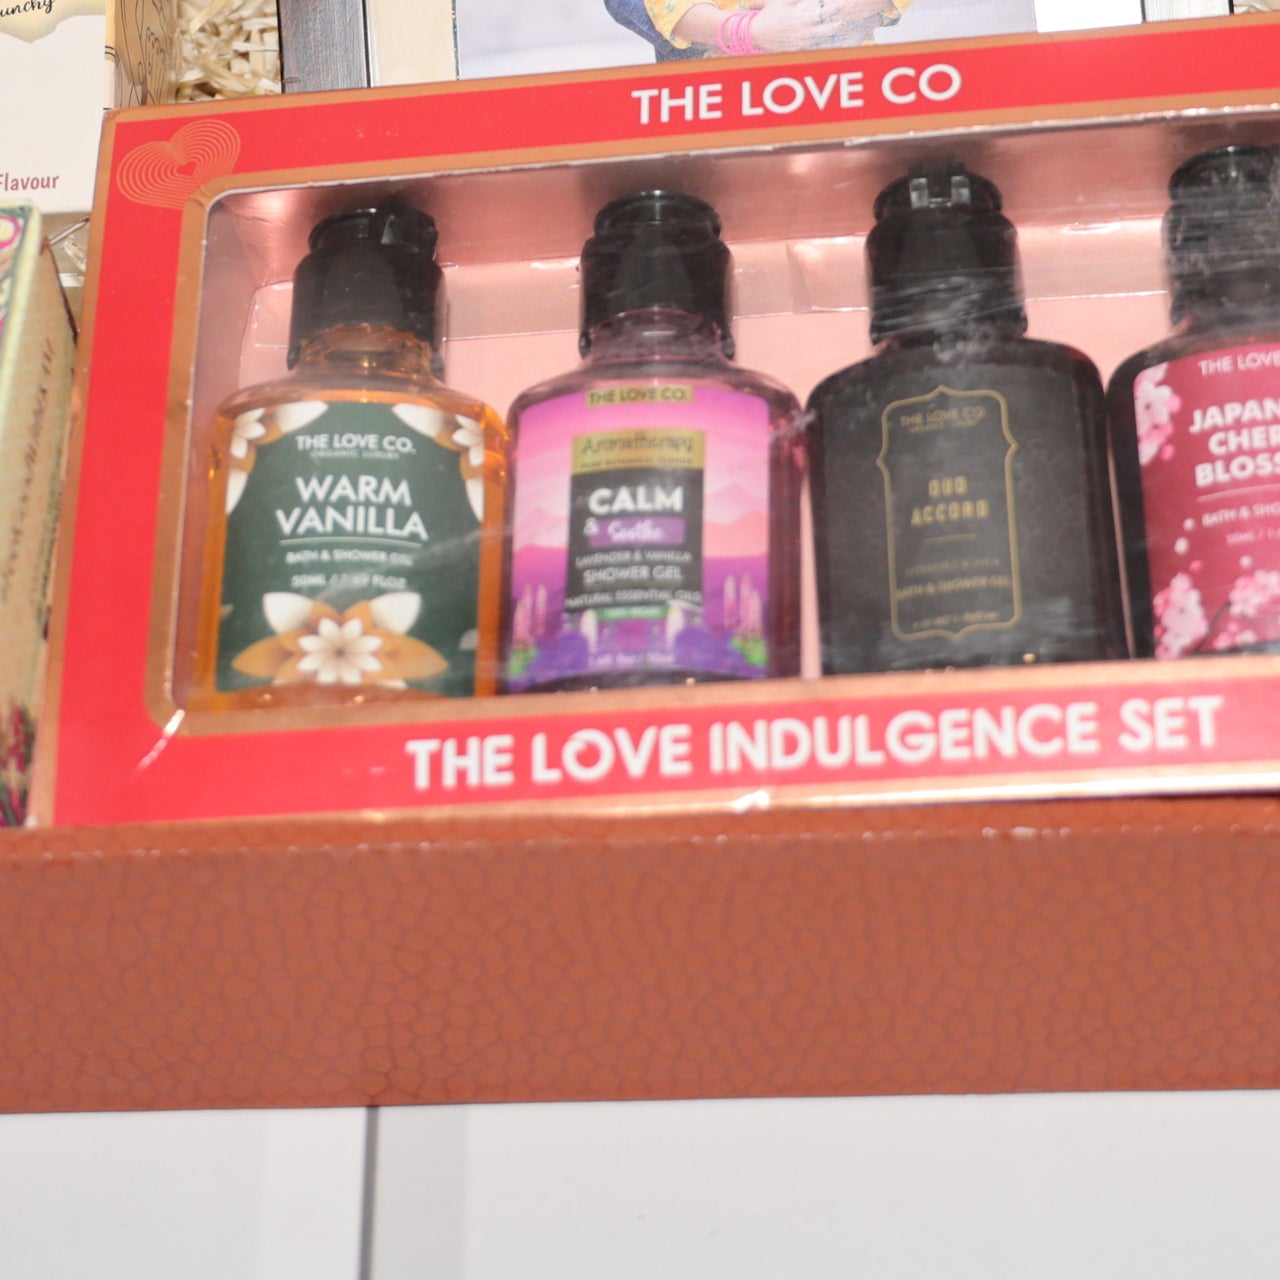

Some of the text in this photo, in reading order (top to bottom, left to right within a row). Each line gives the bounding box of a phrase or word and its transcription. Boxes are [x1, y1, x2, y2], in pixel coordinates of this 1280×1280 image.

[631, 63, 963, 125] THE LOVE CO
[1198, 355, 1233, 376] THE
[589, 390, 615, 404] THE
[619, 387, 657, 402] LOVE
[296, 434, 329, 451] THE
[333, 433, 378, 449] LOVE
[295, 474, 412, 507] WARM
[588, 485, 684, 515] CALM
[275, 504, 429, 541] VANILLA
[583, 517, 600, 536] &
[583, 565, 683, 584] SHOWER GEL
[404, 694, 1225, 792] THE LOVE INDULGENCE SET
